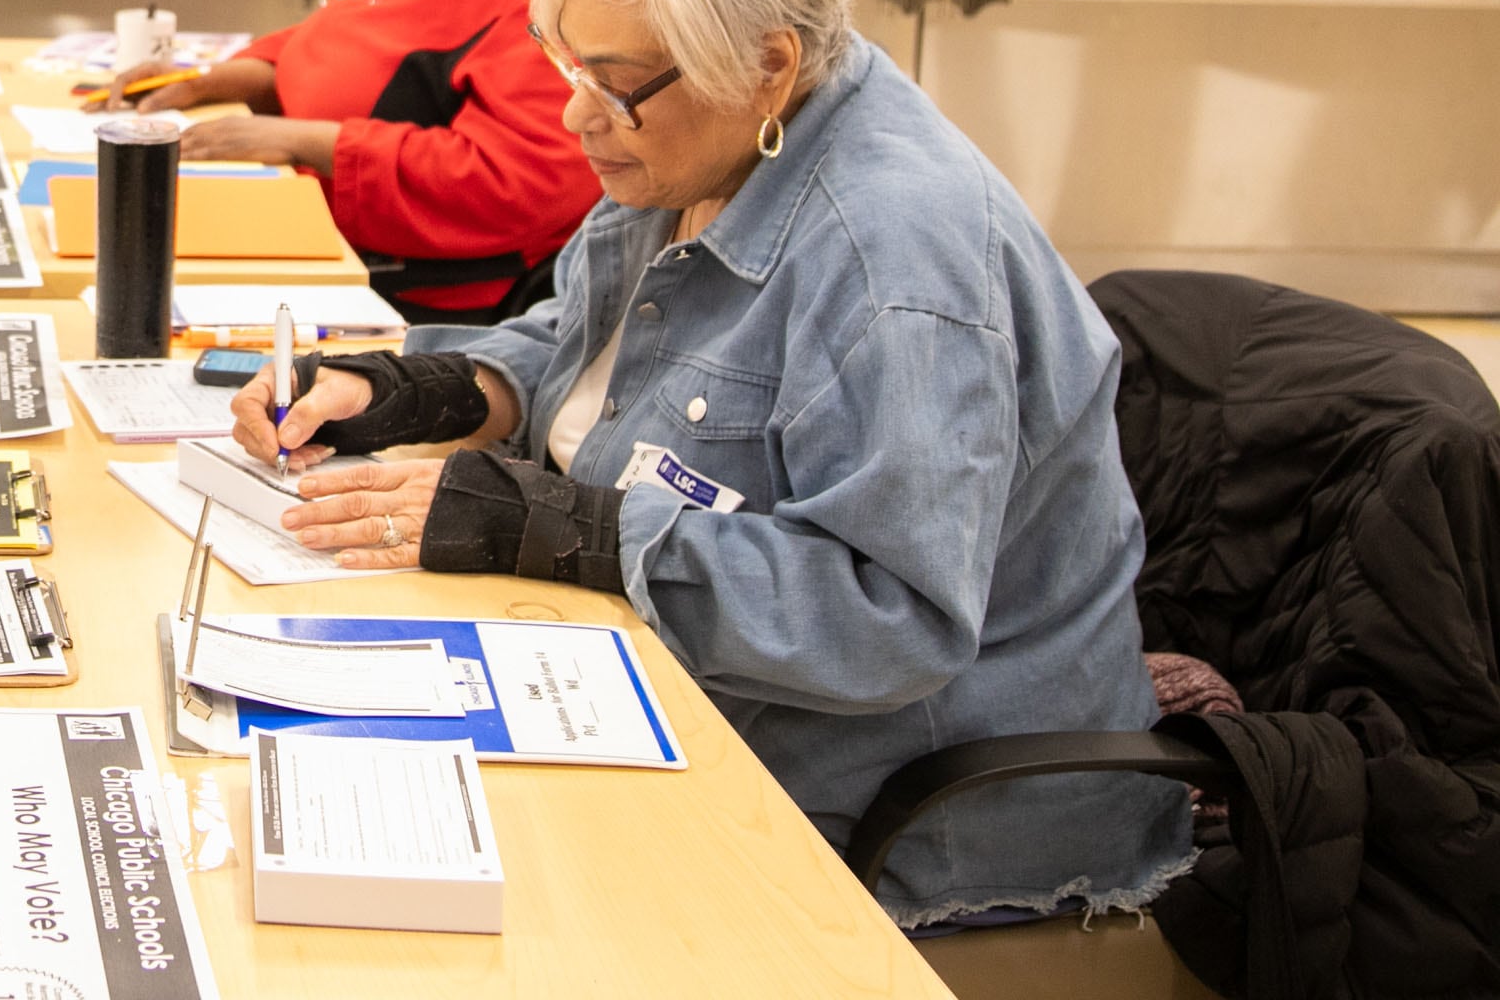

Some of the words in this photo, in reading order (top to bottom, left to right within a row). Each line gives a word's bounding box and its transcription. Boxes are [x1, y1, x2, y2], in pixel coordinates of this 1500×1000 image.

[673, 471, 697, 494] LSC
[460, 663, 475, 681] ILLINOIS
[539, 660, 555, 676] Form
[469, 686, 482, 705] CHICAGO
[524, 684, 543, 700] Used
[543, 677, 561, 694] Ballot
[564, 680, 580, 690] Wd
[550, 695, 563, 704] for
[556, 707, 579, 742] Applications
[582, 724, 599, 737] Pct
[11, 785, 46, 825] Who
[81, 797, 98, 819] LOCAL
[99, 766, 138, 834] Chicago
[84, 820, 104, 852] SCHOOL
[12, 832, 52, 874] May
[115, 838, 156, 891] Public
[88, 854, 110, 887] COUNCIL
[24, 882, 69, 943] Vote?
[94, 889, 119, 930] ELECTIONS
[129, 895, 174, 969] Schools
